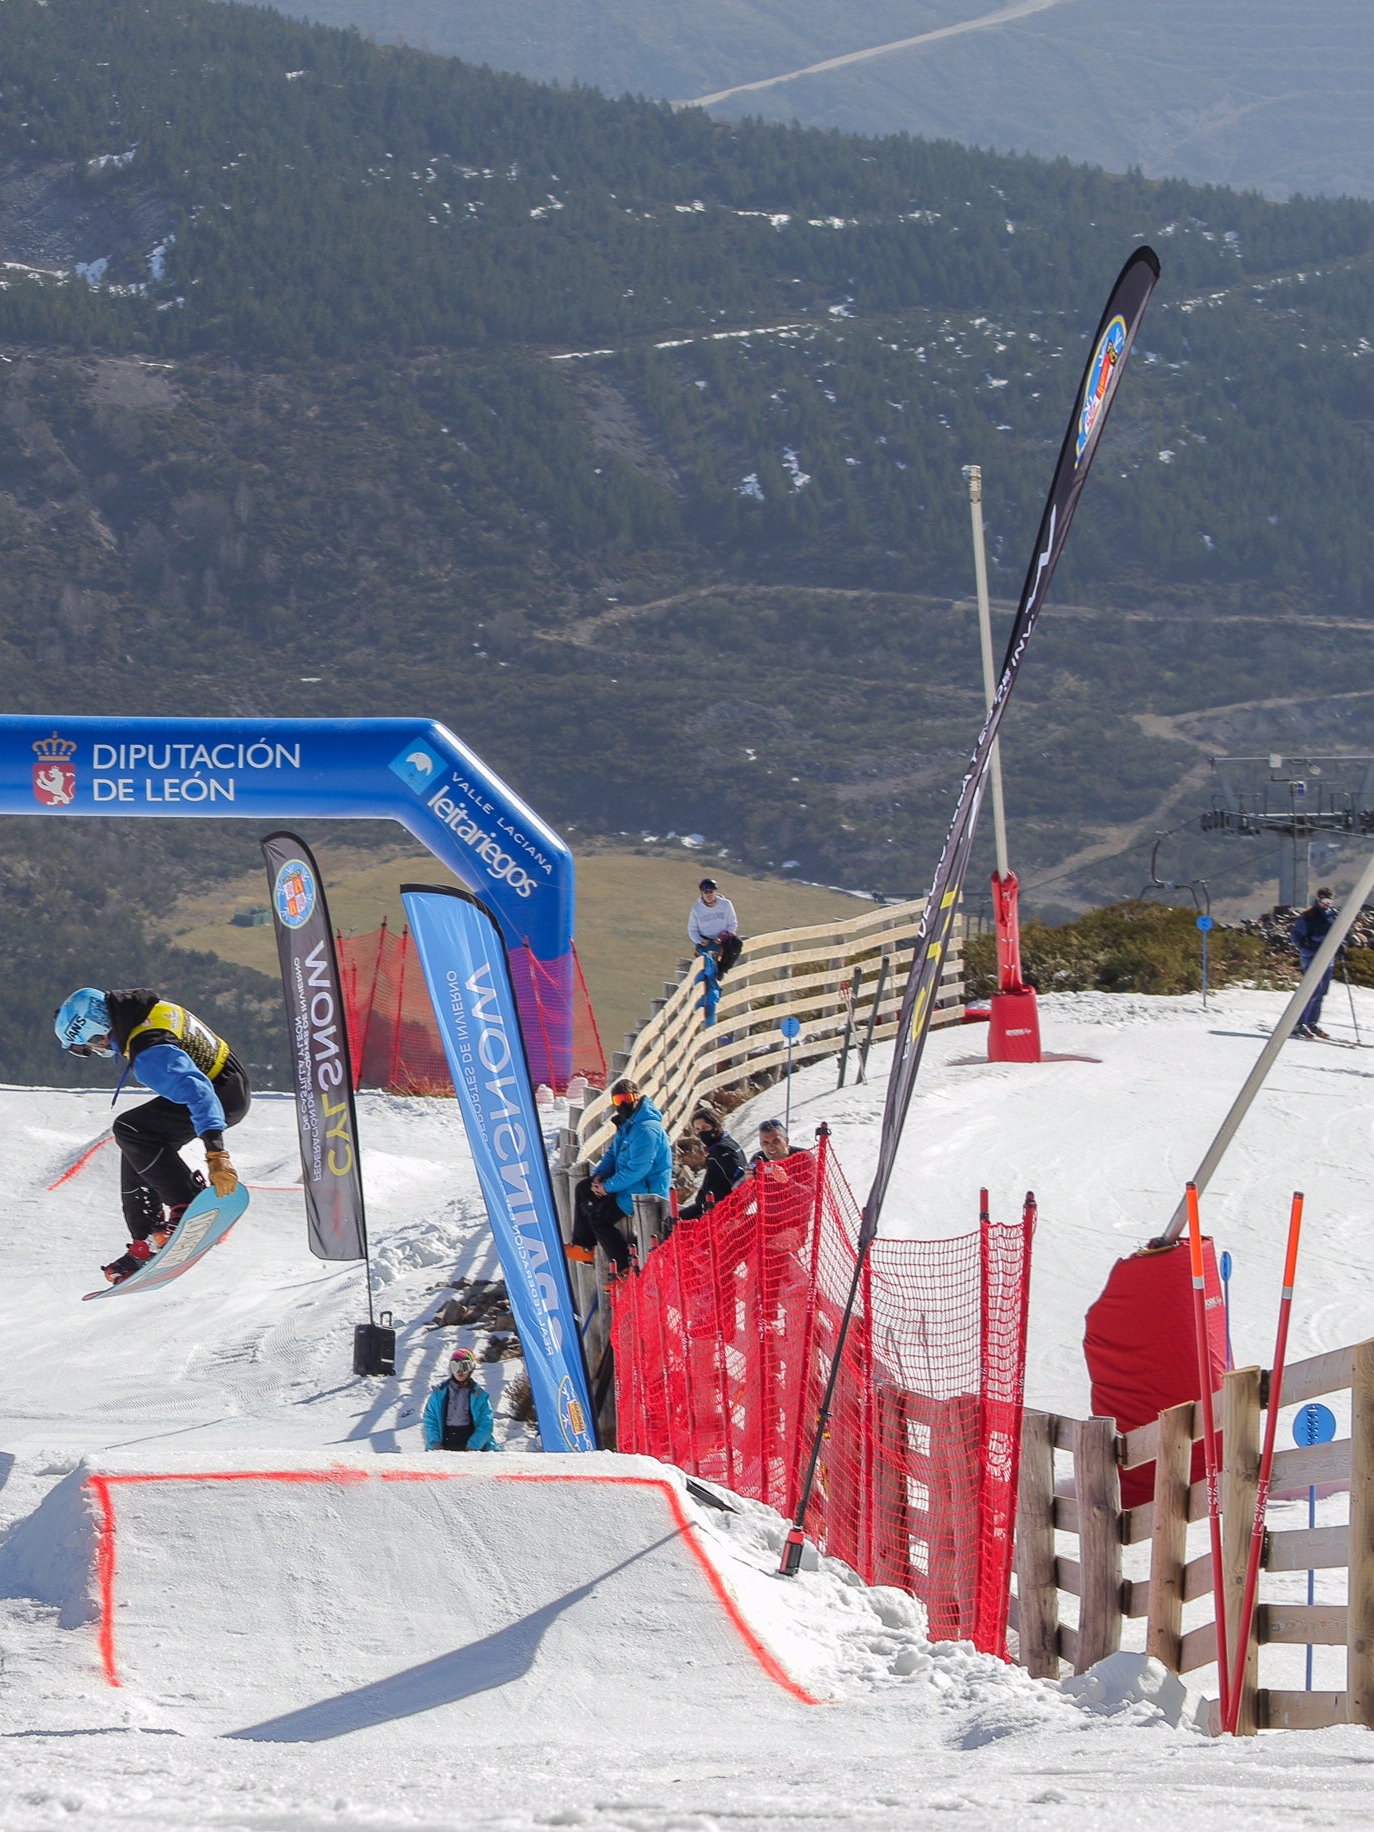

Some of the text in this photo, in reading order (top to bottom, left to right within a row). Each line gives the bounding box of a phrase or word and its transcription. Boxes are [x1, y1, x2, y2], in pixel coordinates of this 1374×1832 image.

[92, 737, 302, 770] DIPUTACIÓN
[92, 770, 236, 802] DE LEÓN
[451, 771, 553, 875] VALLE LACIANA
[427, 785, 539, 898] leitariegos
[66, 1015, 87, 1043] VANS
